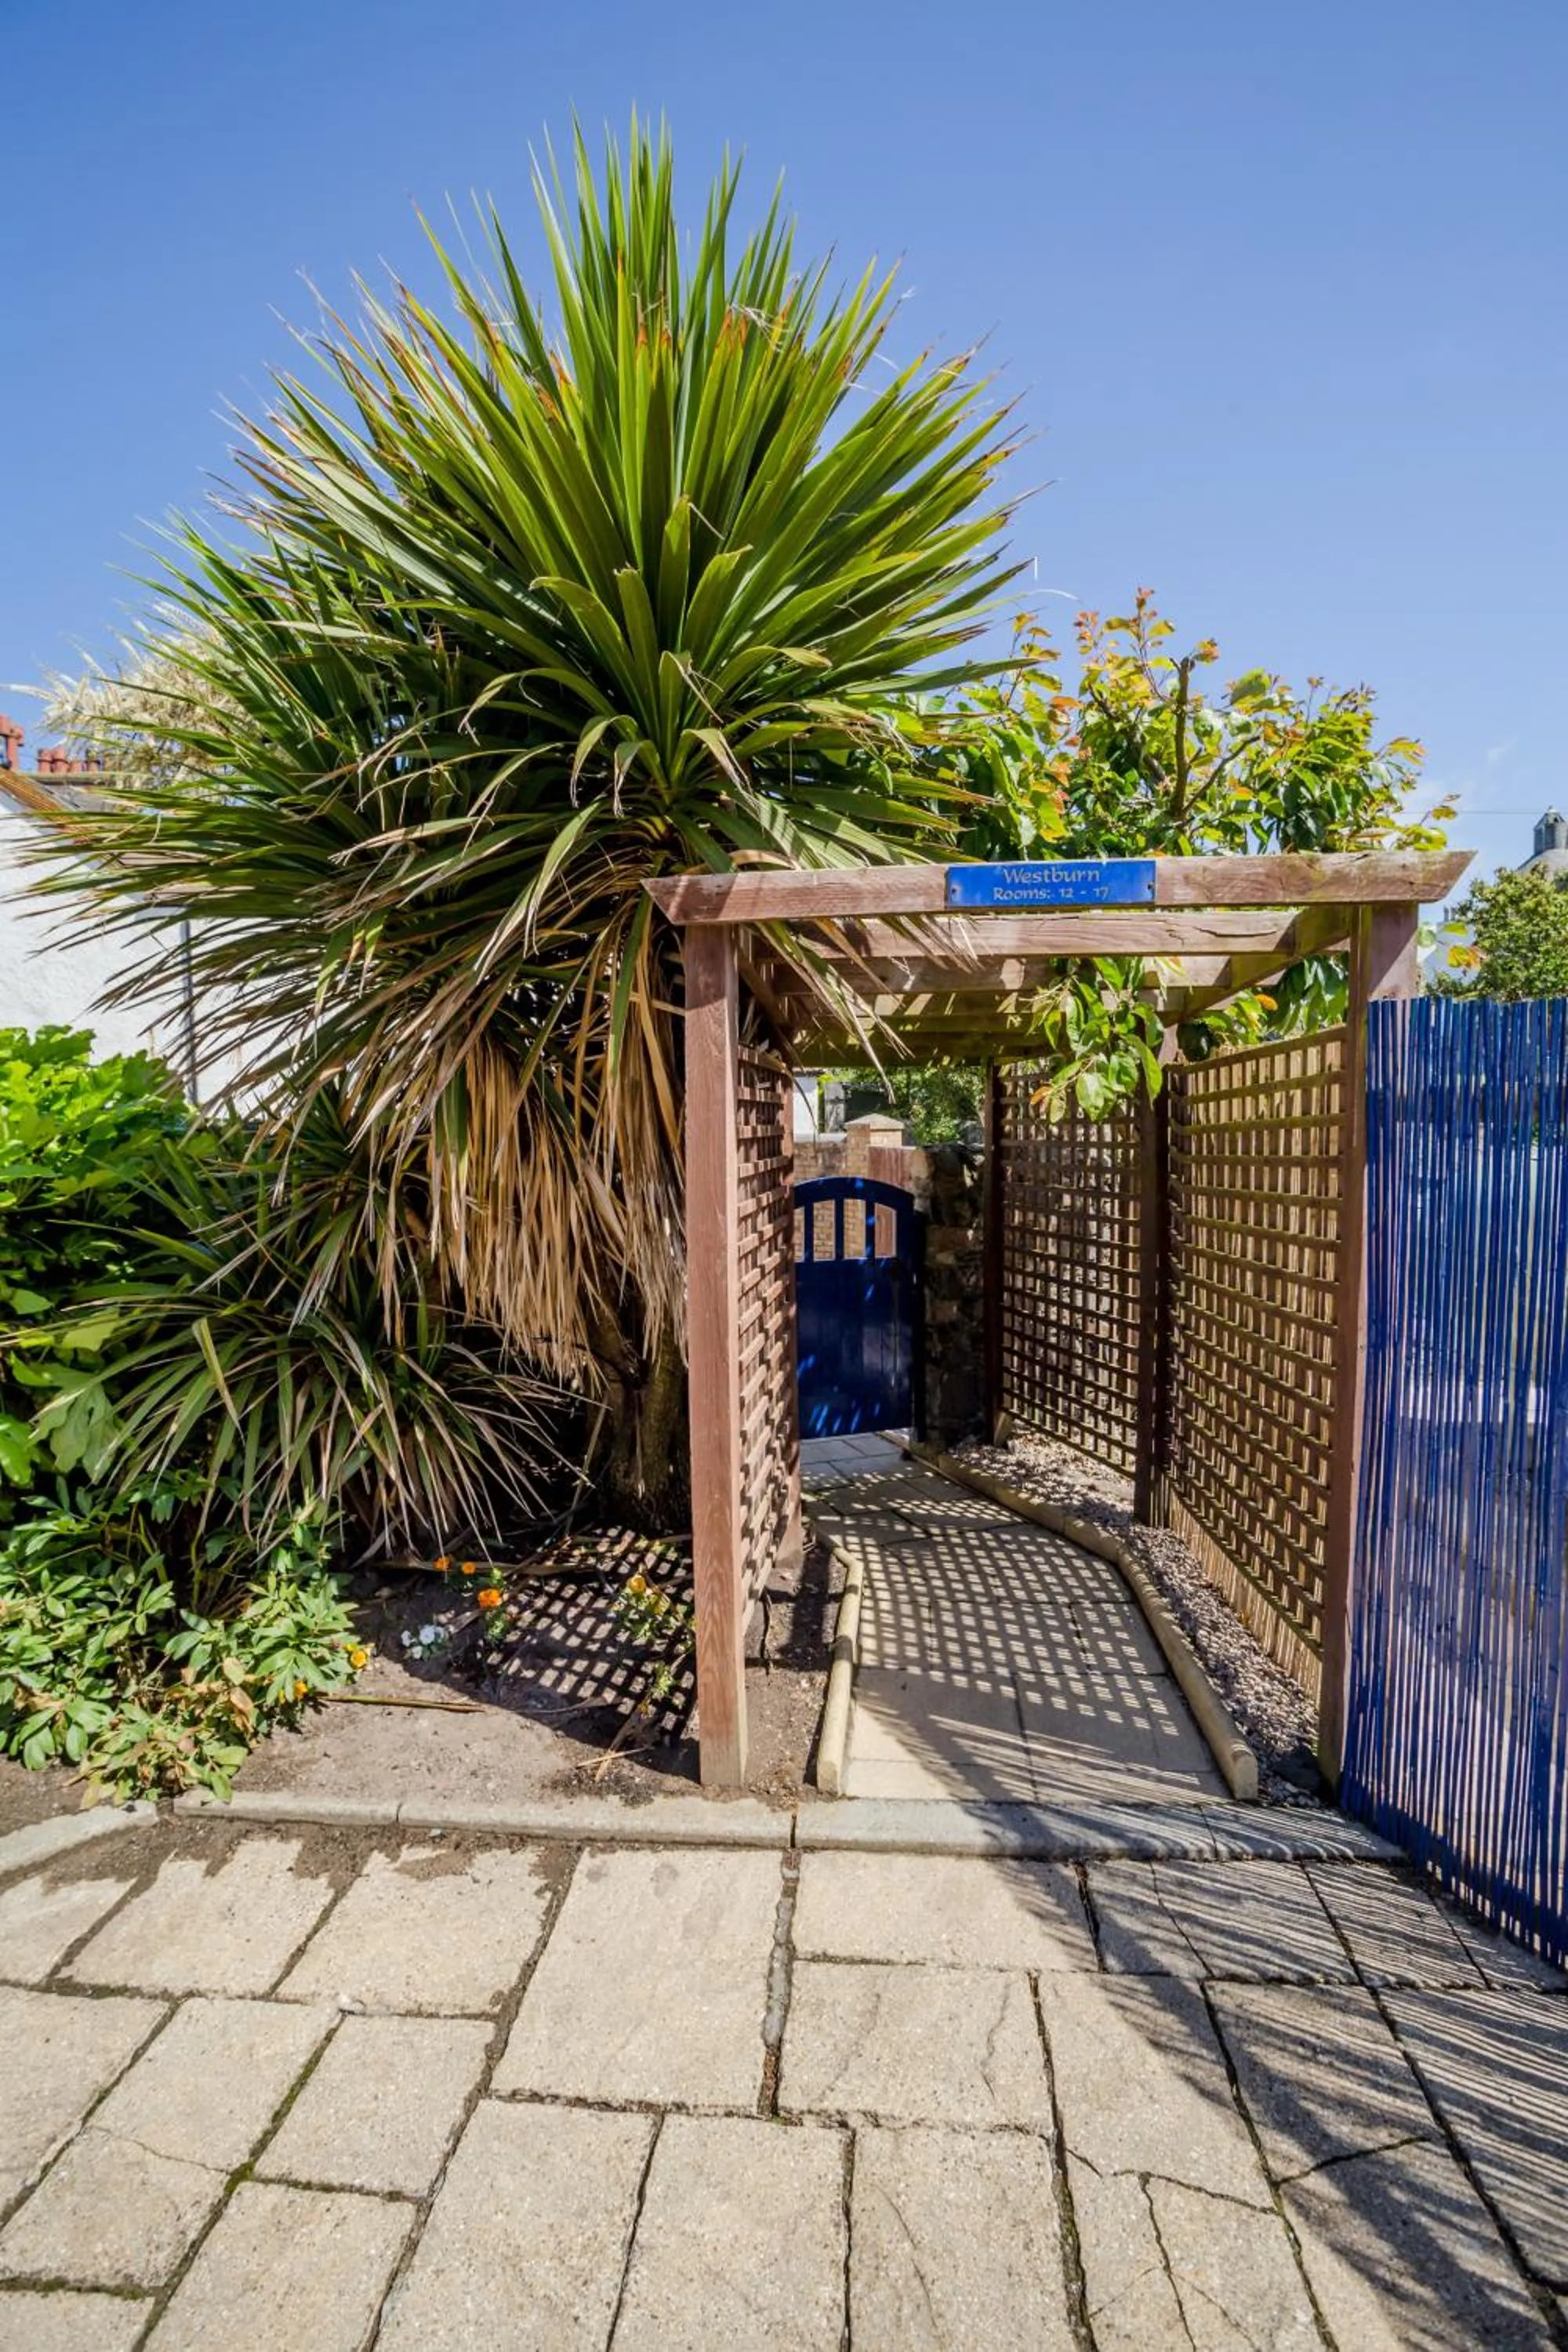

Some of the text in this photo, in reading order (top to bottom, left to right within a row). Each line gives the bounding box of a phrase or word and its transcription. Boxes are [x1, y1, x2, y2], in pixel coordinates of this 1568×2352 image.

[1004, 867, 1100, 884] Westburn
[1059, 888, 1073, 898] 12
[1093, 887, 1109, 898] 17
